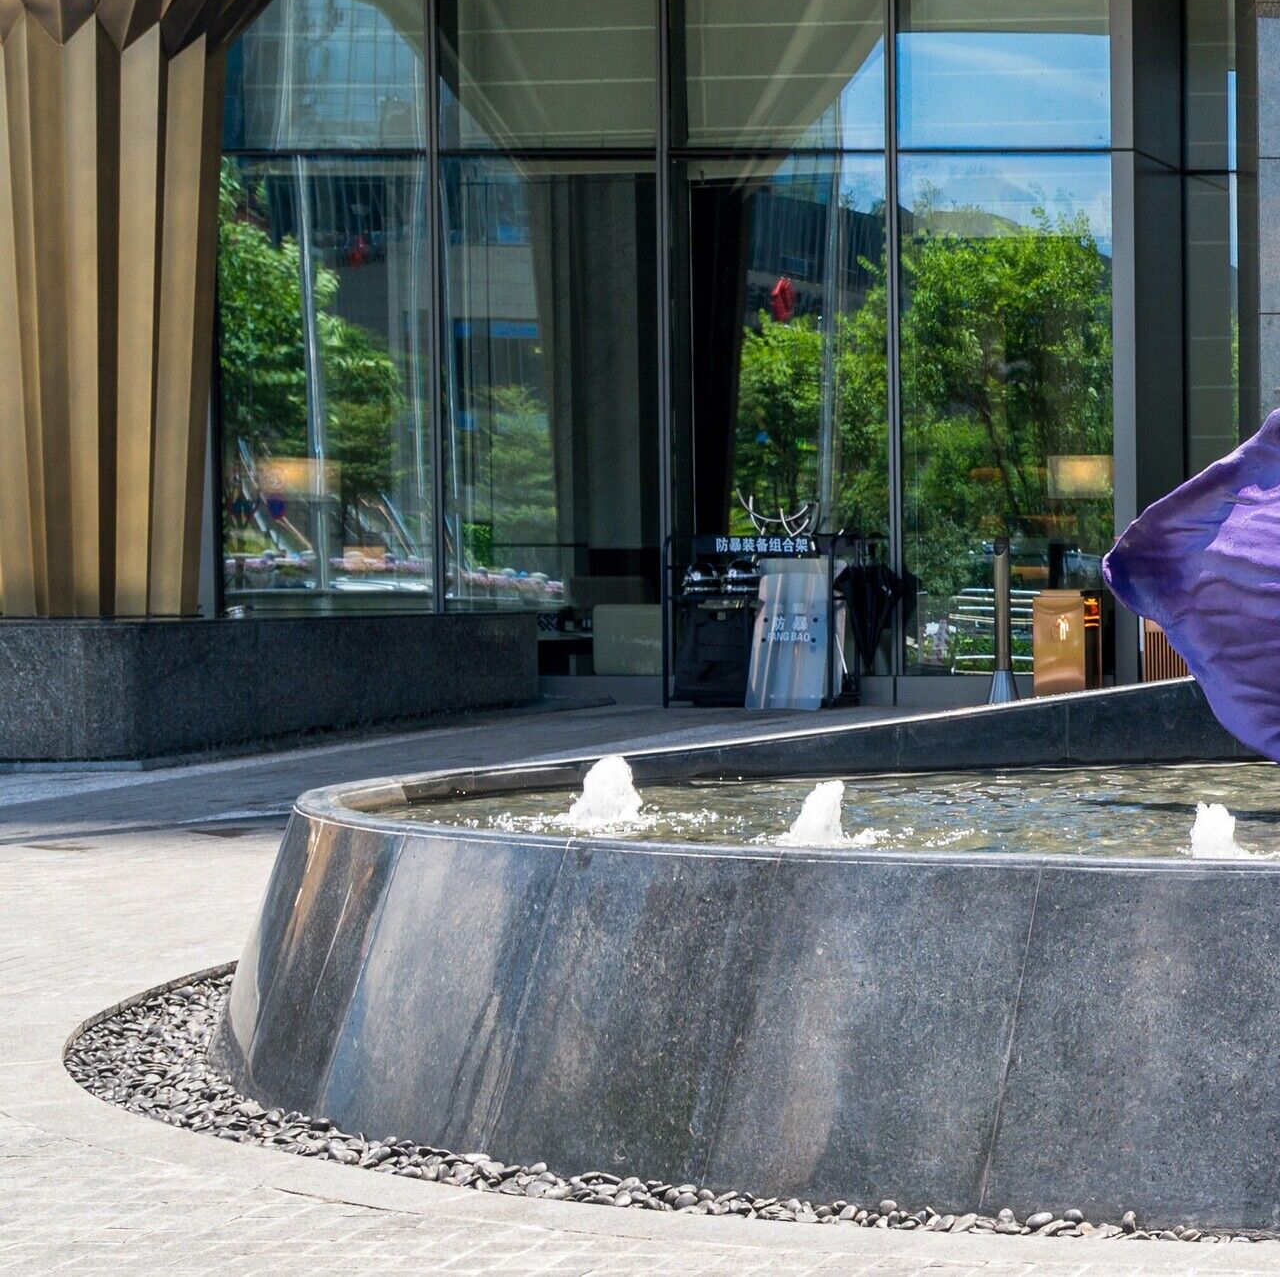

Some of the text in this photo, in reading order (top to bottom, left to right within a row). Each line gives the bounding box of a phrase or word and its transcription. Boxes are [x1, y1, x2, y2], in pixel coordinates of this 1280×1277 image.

[716, 538, 808, 552] 防暴装备组合架
[773, 616, 808, 631] 防暴
[767, 632, 810, 642] FANG BAO
